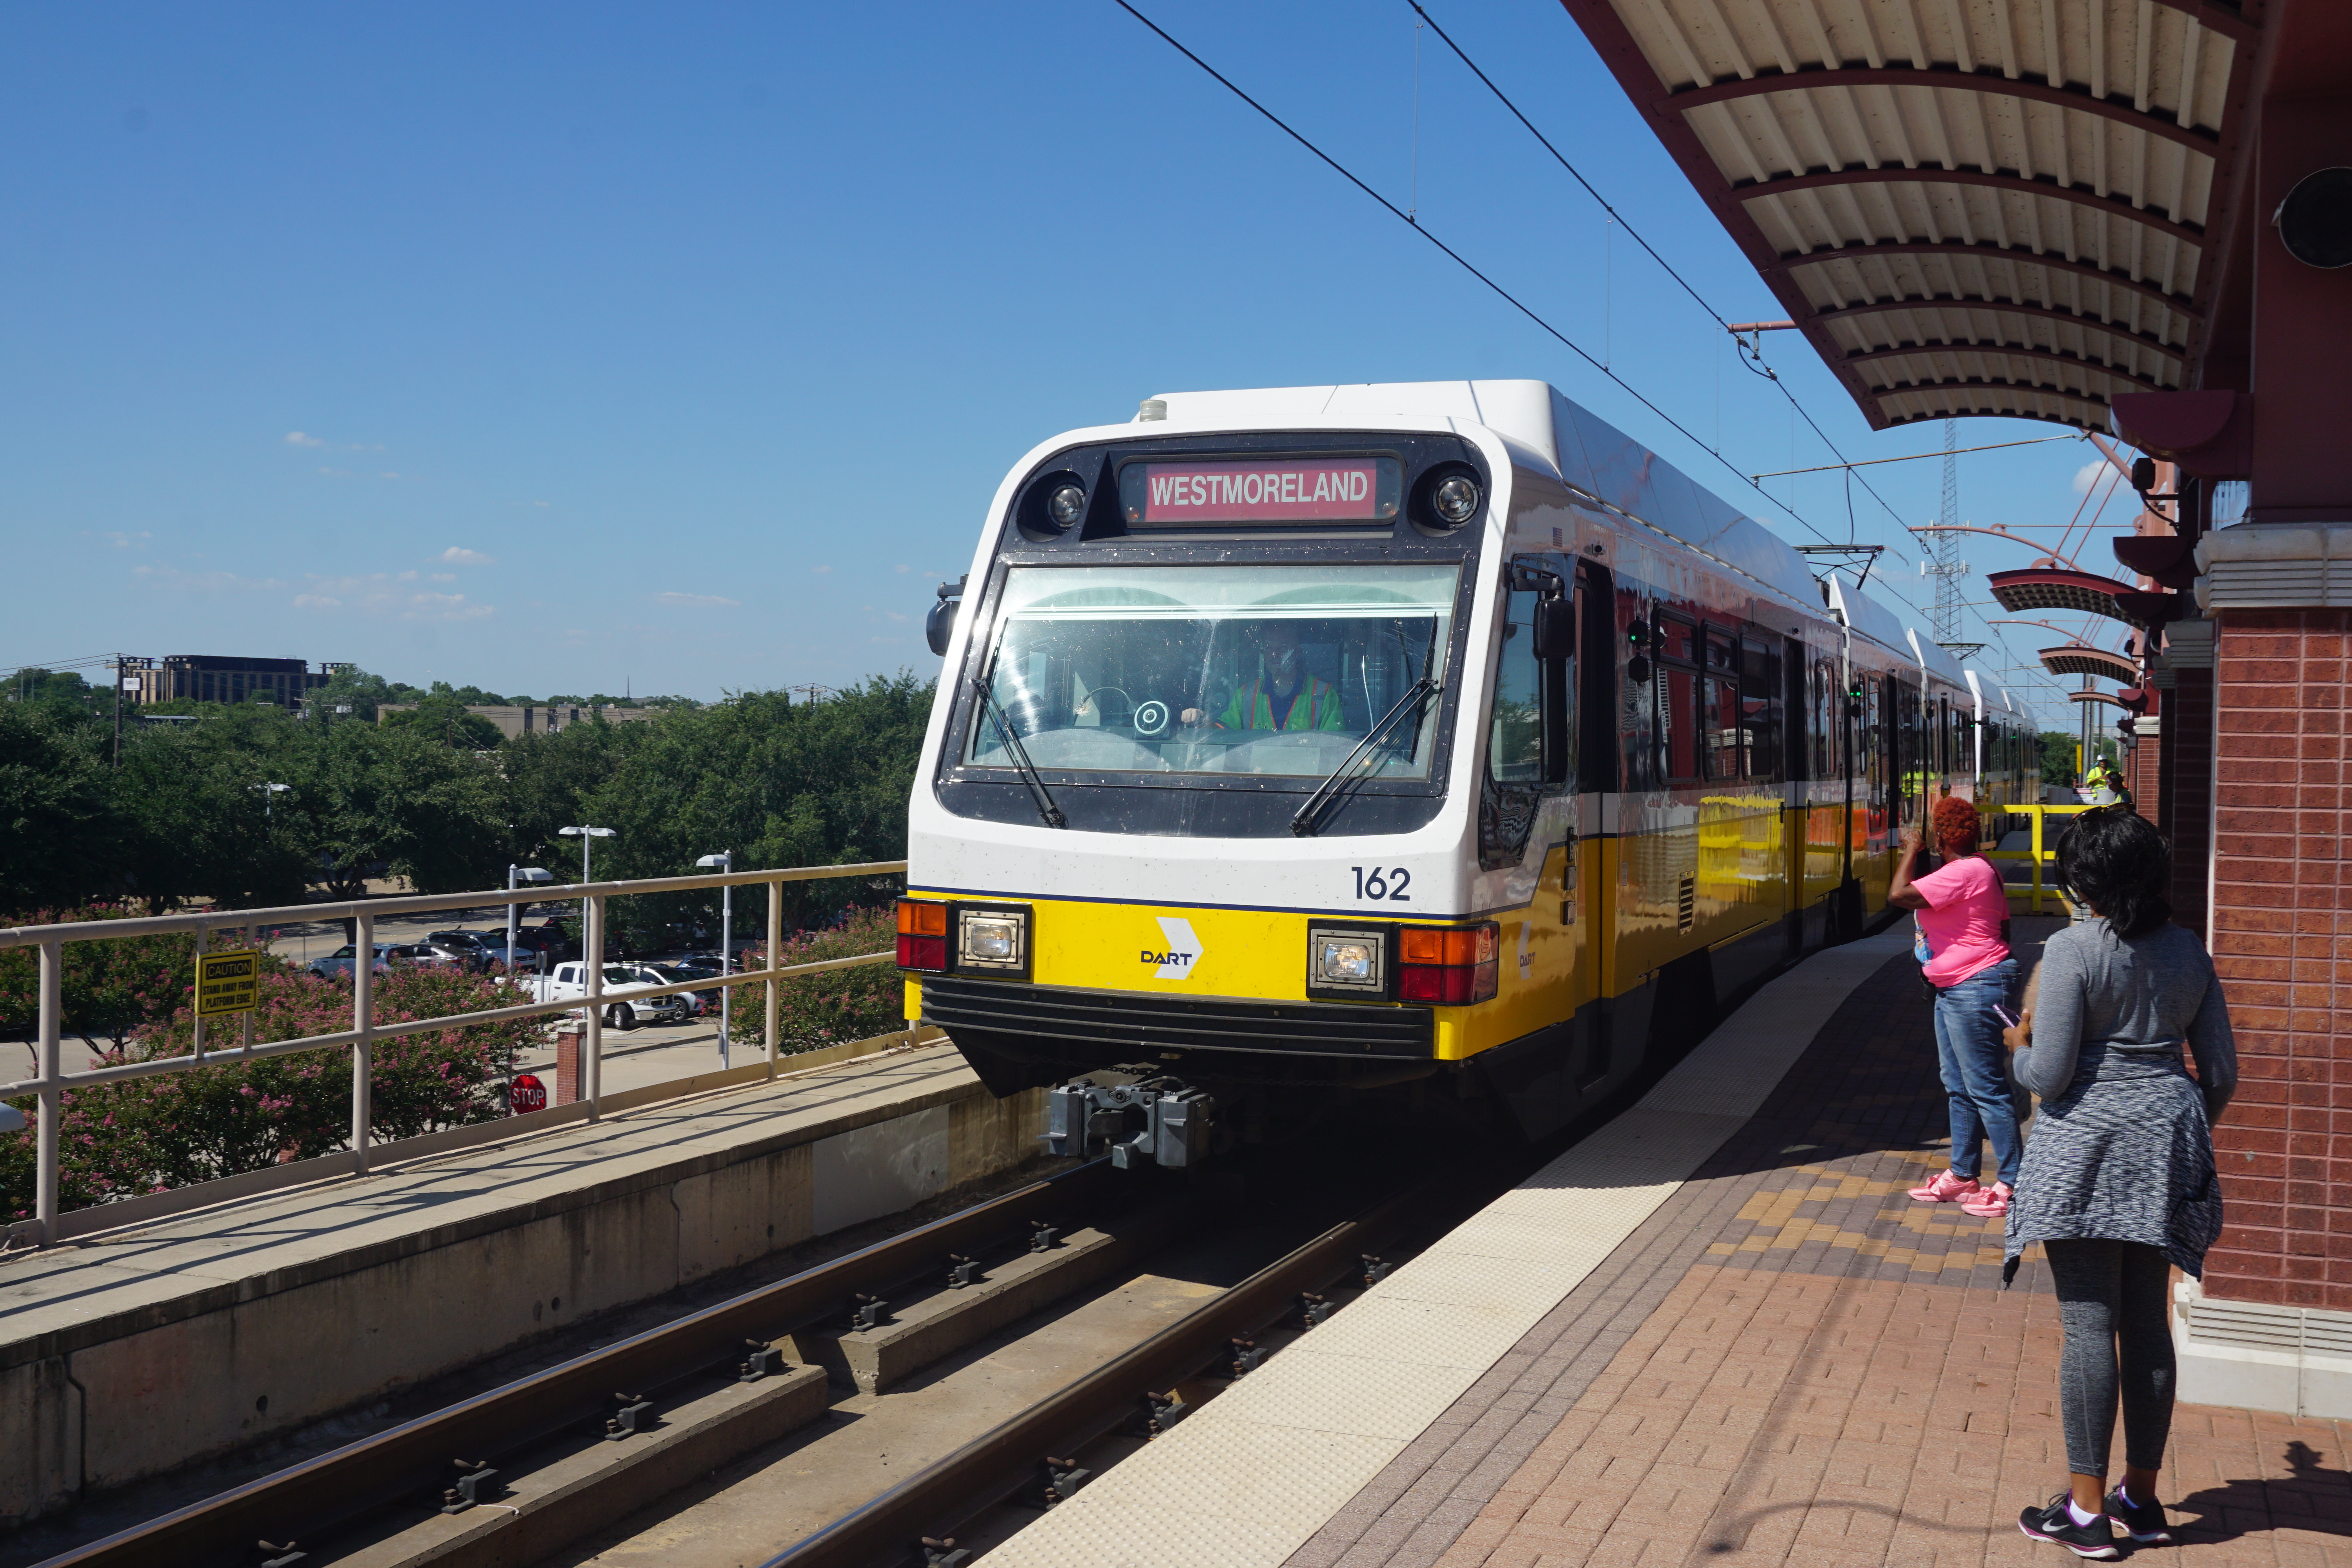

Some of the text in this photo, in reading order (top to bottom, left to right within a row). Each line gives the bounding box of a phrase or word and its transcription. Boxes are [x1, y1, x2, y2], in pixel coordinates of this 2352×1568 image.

[1152, 472, 1367, 506] WESTMORELAND
[1352, 867, 1410, 901] 162
[1141, 951, 1192, 965] DART
[1520, 951, 1535, 967] DART
[208, 962, 250, 977] CAUTION
[203, 980, 254, 995] STAND AWAY FROM
[206, 993, 250, 1008] PLATFORM EDGE
[512, 1088, 544, 1105] STOP
